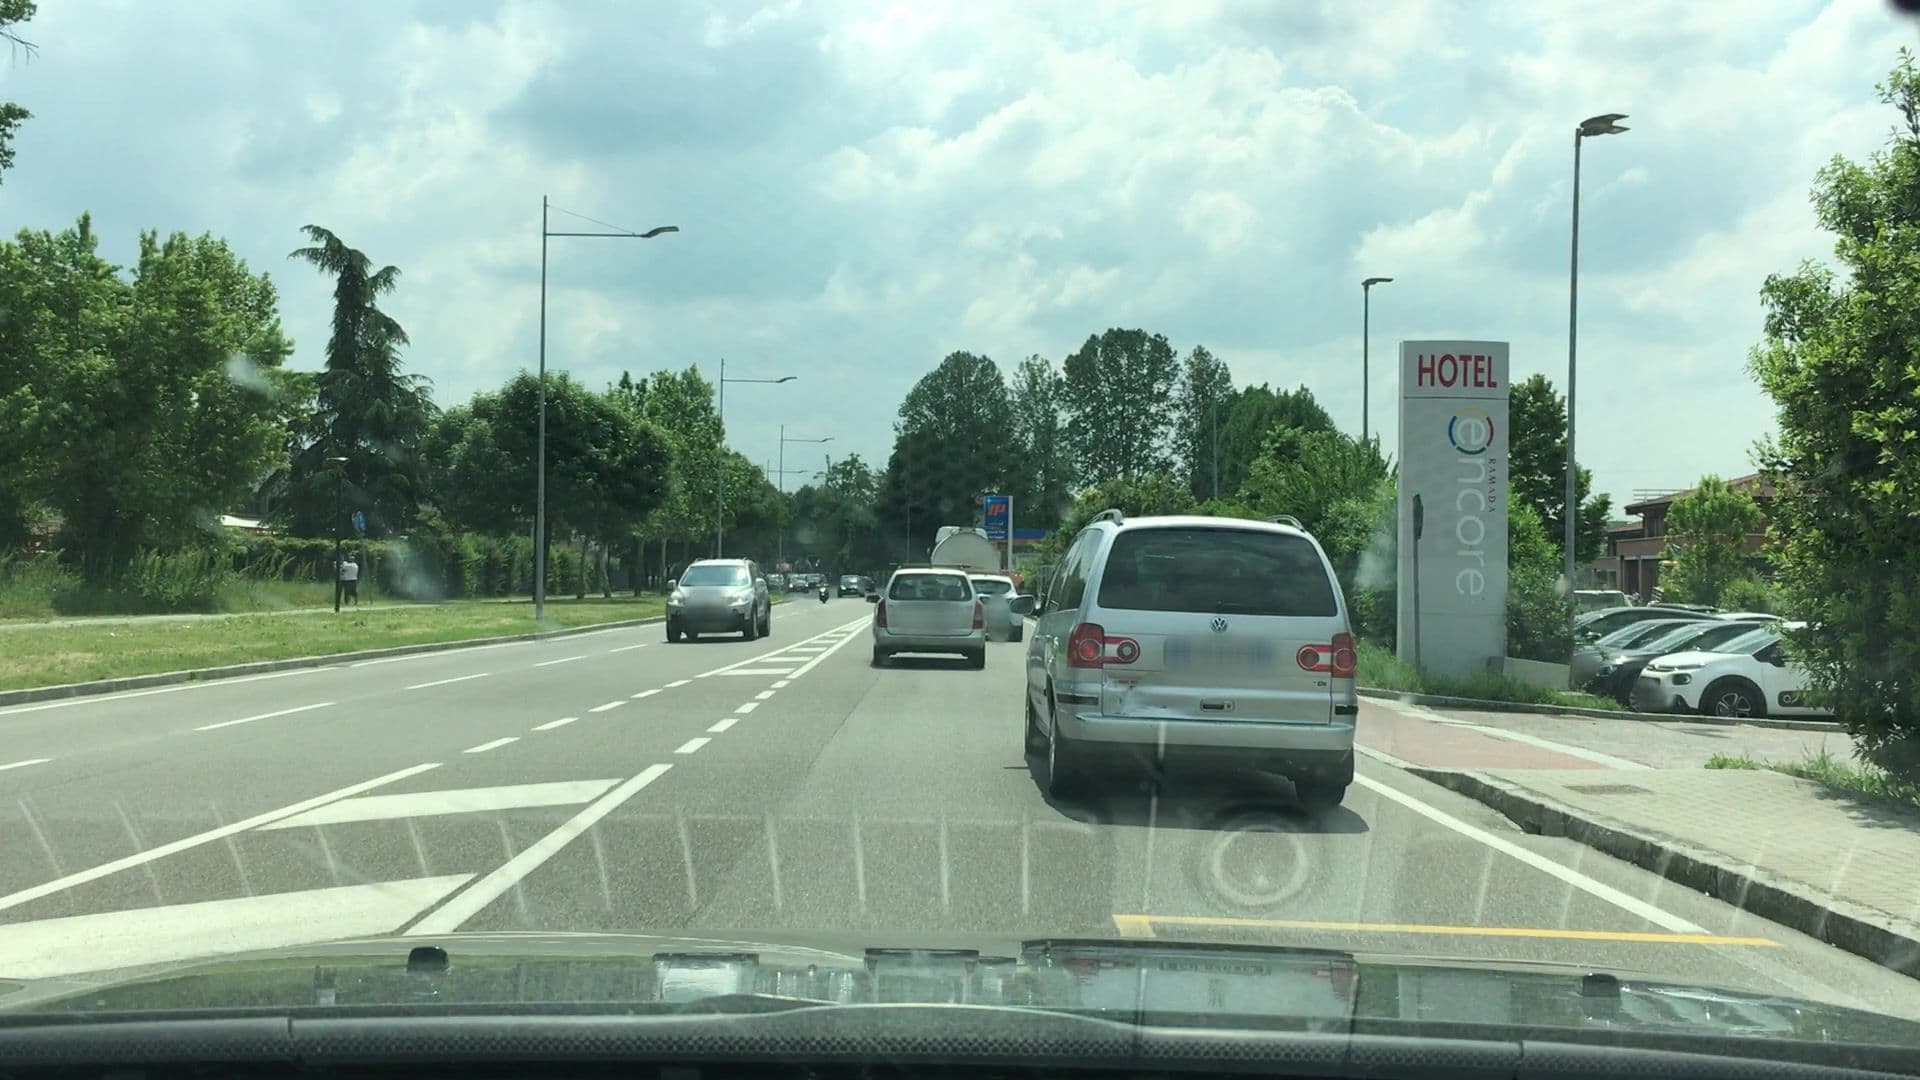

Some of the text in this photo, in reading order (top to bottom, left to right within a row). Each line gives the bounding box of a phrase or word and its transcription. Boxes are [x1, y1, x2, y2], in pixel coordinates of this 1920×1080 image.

[1417, 353, 1498, 388] HOTEL
[1455, 417, 1487, 596] encore
[1488, 457, 1497, 514] RAMADA
